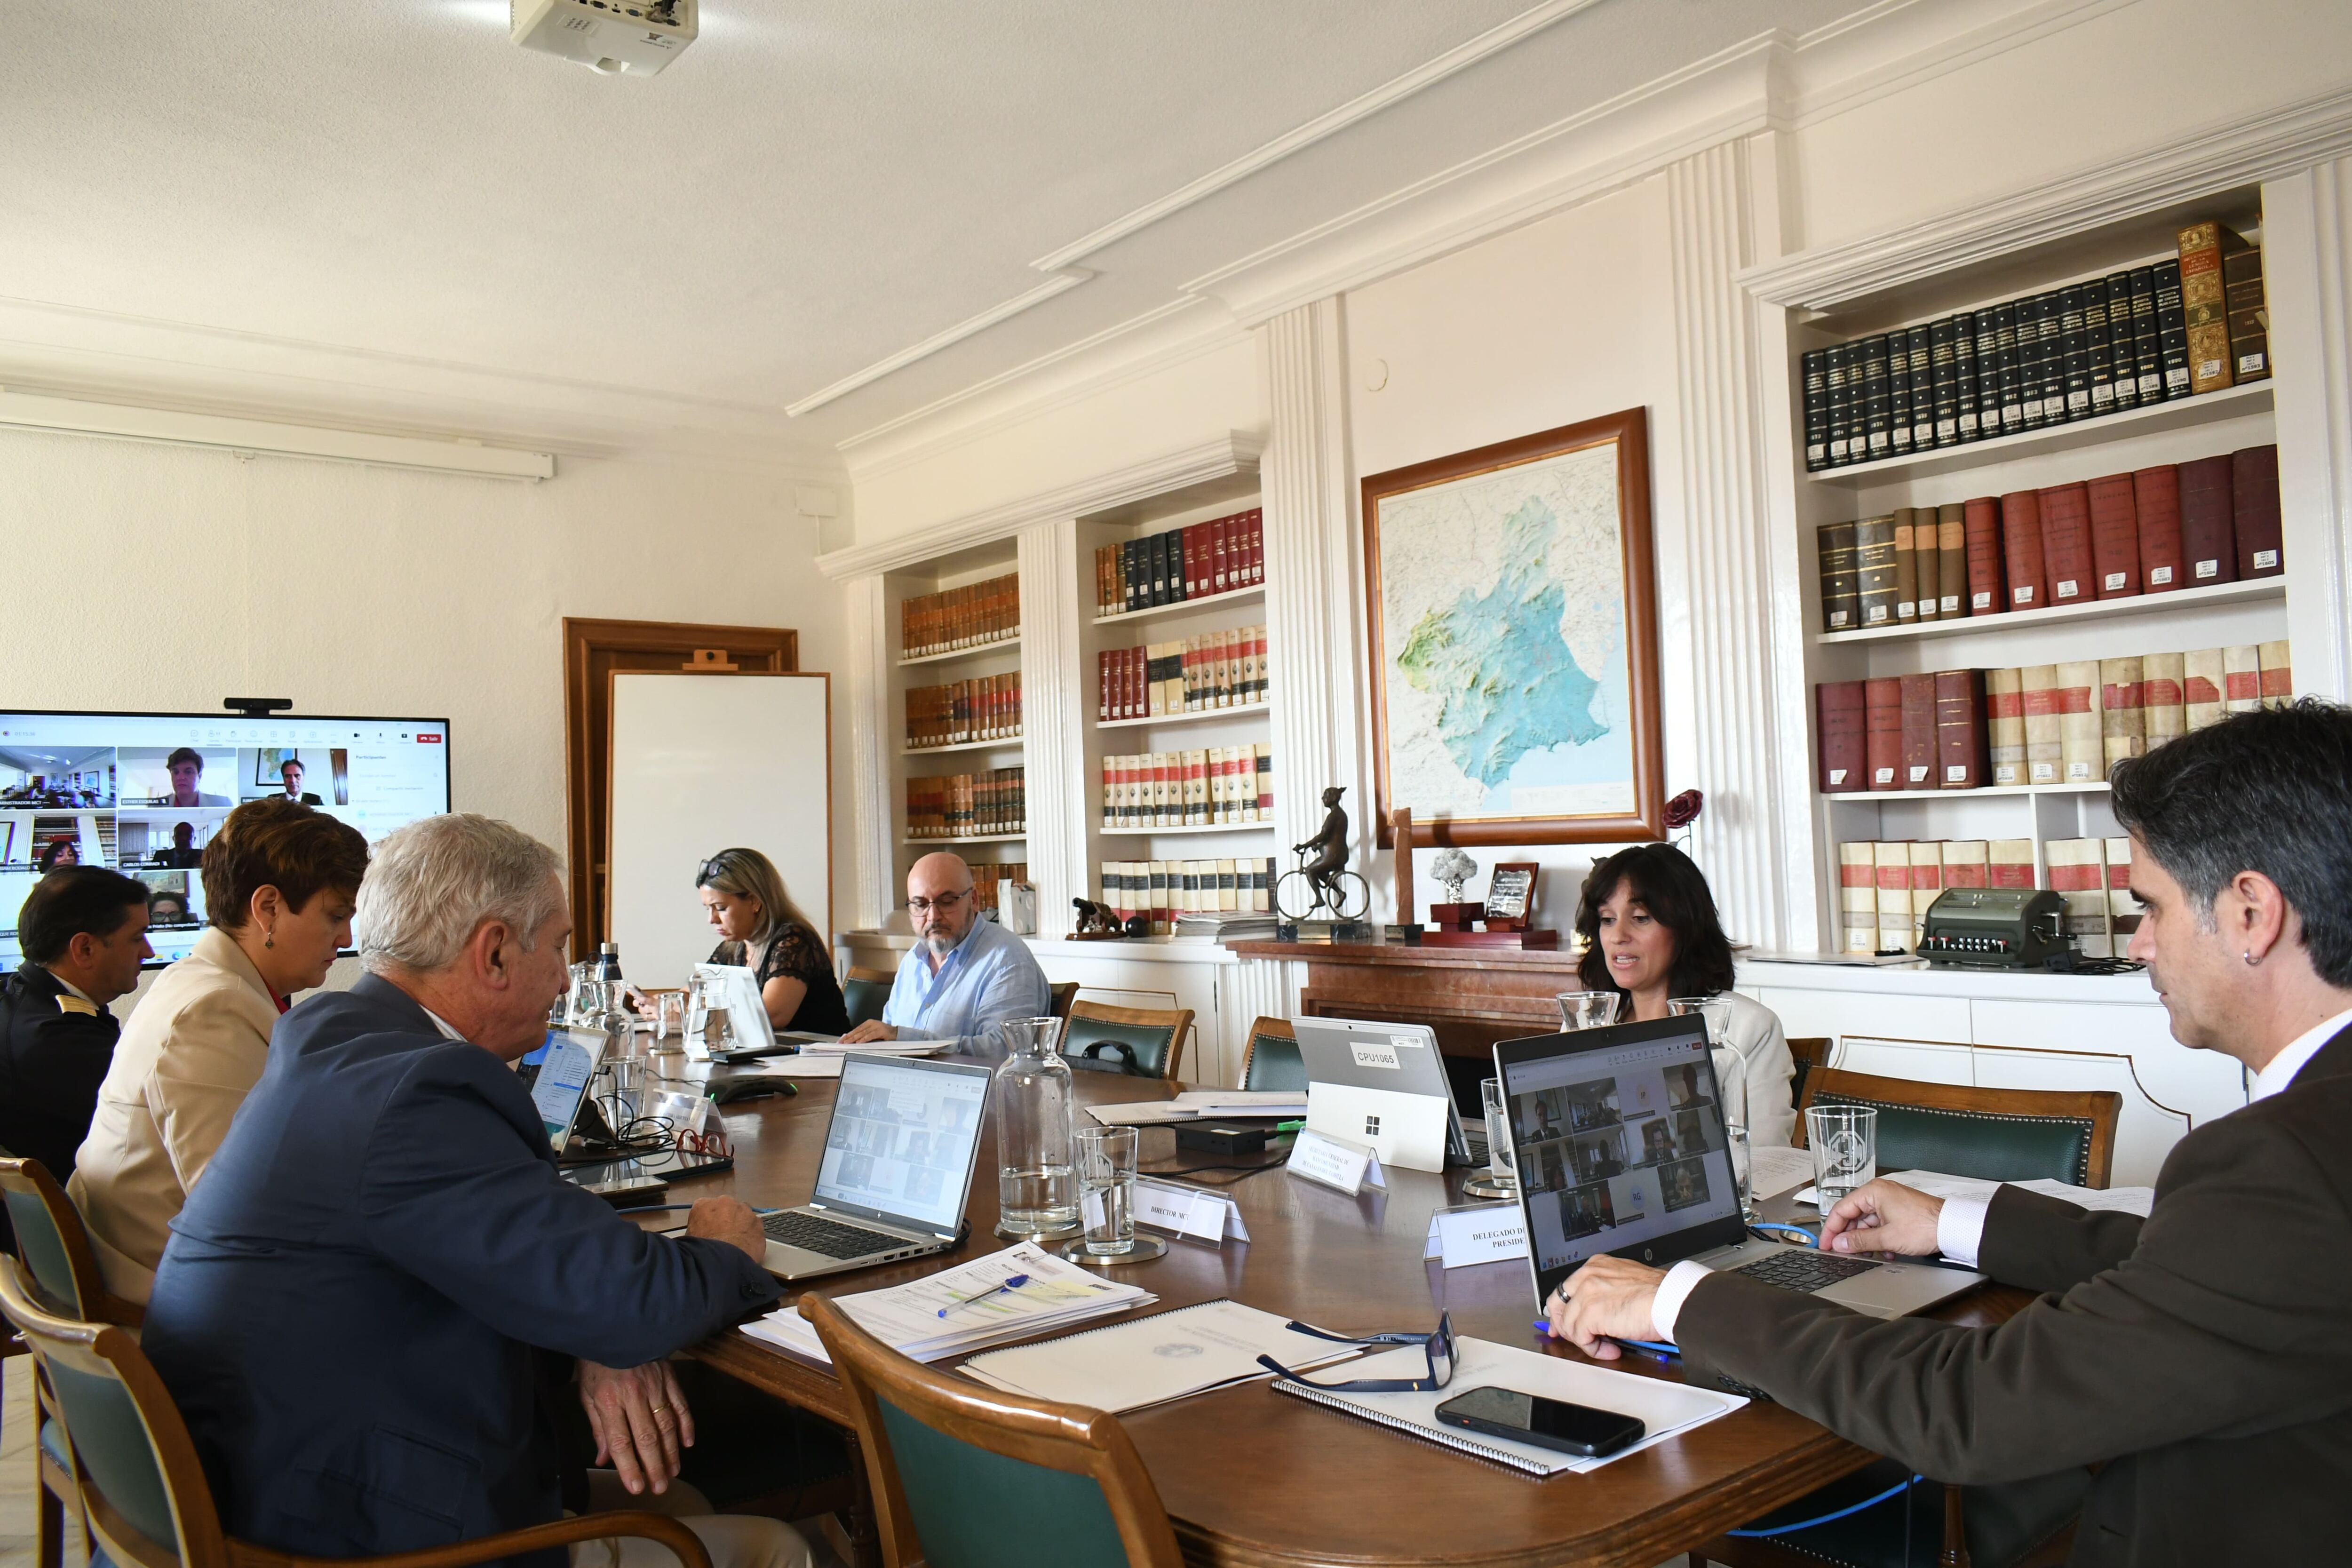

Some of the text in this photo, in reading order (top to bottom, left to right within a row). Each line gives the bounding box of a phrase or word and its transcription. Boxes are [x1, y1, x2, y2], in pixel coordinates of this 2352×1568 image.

[1358, 1052, 1394, 1064] CPU1065
[1640, 1091, 1646, 1099] JP
[1633, 1193, 1641, 1202] RG
[1151, 1206, 1176, 1217] DIRECTOR
[1473, 1228, 1515, 1241] DELEGADO
[1493, 1237, 1525, 1248] PRESIDE
